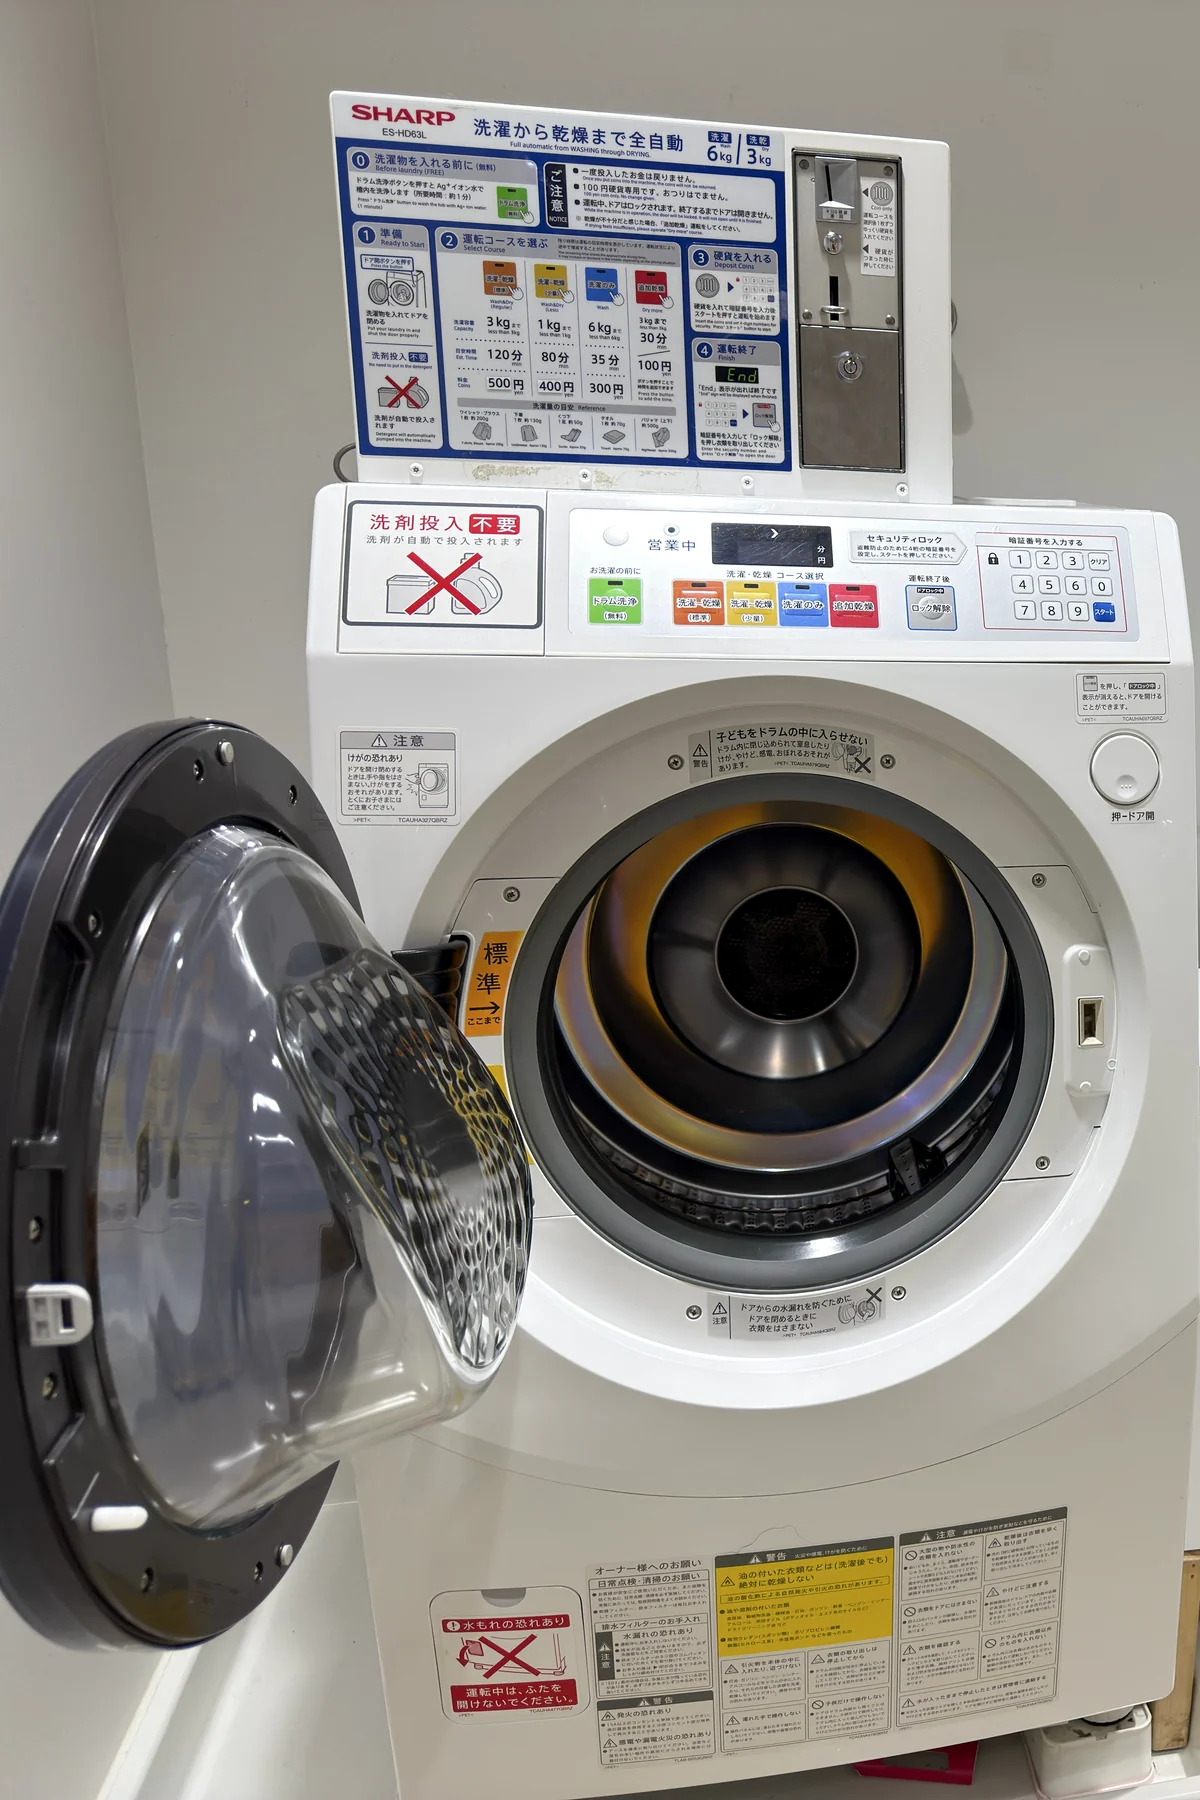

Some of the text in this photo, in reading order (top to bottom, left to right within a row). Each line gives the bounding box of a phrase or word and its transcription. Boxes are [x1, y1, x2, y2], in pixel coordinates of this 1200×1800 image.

[352, 104, 455, 125] SHARP
[382, 128, 426, 139] ES-HD63L
[473, 118, 683, 152] 洗濯から乾燥まで全自動
[710, 132, 769, 146] 洗濯 洗乾
[601, 148, 625, 157] through
[375, 153, 473, 171] 洗濯物を入れる前に
[376, 165, 397, 173] Before
[398, 166, 423, 175] laundry
[582, 169, 696, 183] 一度投入したお金は戻りません。
[550, 170, 564, 213] ご注意
[549, 216, 567, 224] NOTICE
[380, 229, 402, 239] 準備
[381, 239, 400, 247] Ready
[410, 240, 425, 248] Start
[463, 234, 548, 249] 運転コースを選ぶ
[714, 251, 772, 263] 硬貨を入れる
[588, 281, 664, 293] 洗濯のみ 追加乾燥
[641, 333, 667, 344] 30分
[488, 349, 523, 361] 120分
[717, 344, 756, 355] 運転終了
[371, 351, 428, 362] 洗剤投入 不要
[591, 354, 619, 366] 35分
[638, 360, 671, 372] 100円
[727, 368, 756, 382] End
[590, 383, 624, 395] 300円
[374, 415, 435, 424] 洗剤が自動で投入さ
[370, 514, 518, 533] 洗剤投入 不要
[366, 535, 523, 546] 洗剤が自動で投入されます
[866, 535, 942, 544] セキュリティロック
[1008, 537, 1083, 546] 暗証番号を入力する
[648, 540, 696, 551] 営業中
[817, 545, 825, 553] 分
[1016, 555, 1108, 566] 1 2 3 クリア
[590, 567, 641, 575] お洗濯の前に
[776, 571, 824, 580] コース選択
[908, 574, 950, 583] 運転終了後
[1019, 580, 1105, 591] 4 5 6 0
[592, 597, 951, 613] ドラム洗浄 洗濯のみ 追加乾燥 ロック解除
[1021, 606, 1028, 616] 7
[1048, 607, 1055, 616] 8
[1074, 607, 1082, 617] 9
[394, 735, 424, 746] 注意
[693, 727, 868, 768] 警告 子どもをドラムの中に入らせない
[348, 754, 402, 762] けがの恐れあり
[476, 943, 508, 995] 標準
[468, 1017, 500, 1025] ここまで
[741, 1295, 852, 1312] ドアからの水漏れを防ぐために
[749, 1313, 816, 1323] ドアを閉めるときに
[749, 1323, 813, 1332] 衣類をはさまない
[936, 1530, 956, 1539] 注意
[766, 1553, 786, 1562] 警告
[595, 1559, 702, 1575] オーナー様へのお願い
[739, 1575, 814, 1589] 絶対に乾燥しない
[463, 1617, 564, 1630] 水もれの恐れあり
[602, 1616, 701, 1630] 排水フィルターのお手入れ
[623, 1628, 693, 1640] 水漏れの恐れあり
[466, 1683, 562, 1697] 運転中は、ふたを
[456, 1695, 574, 1710] 開けないでください。
[653, 1697, 673, 1705] 警告
[617, 1708, 671, 1718] 発火の恐れあり
